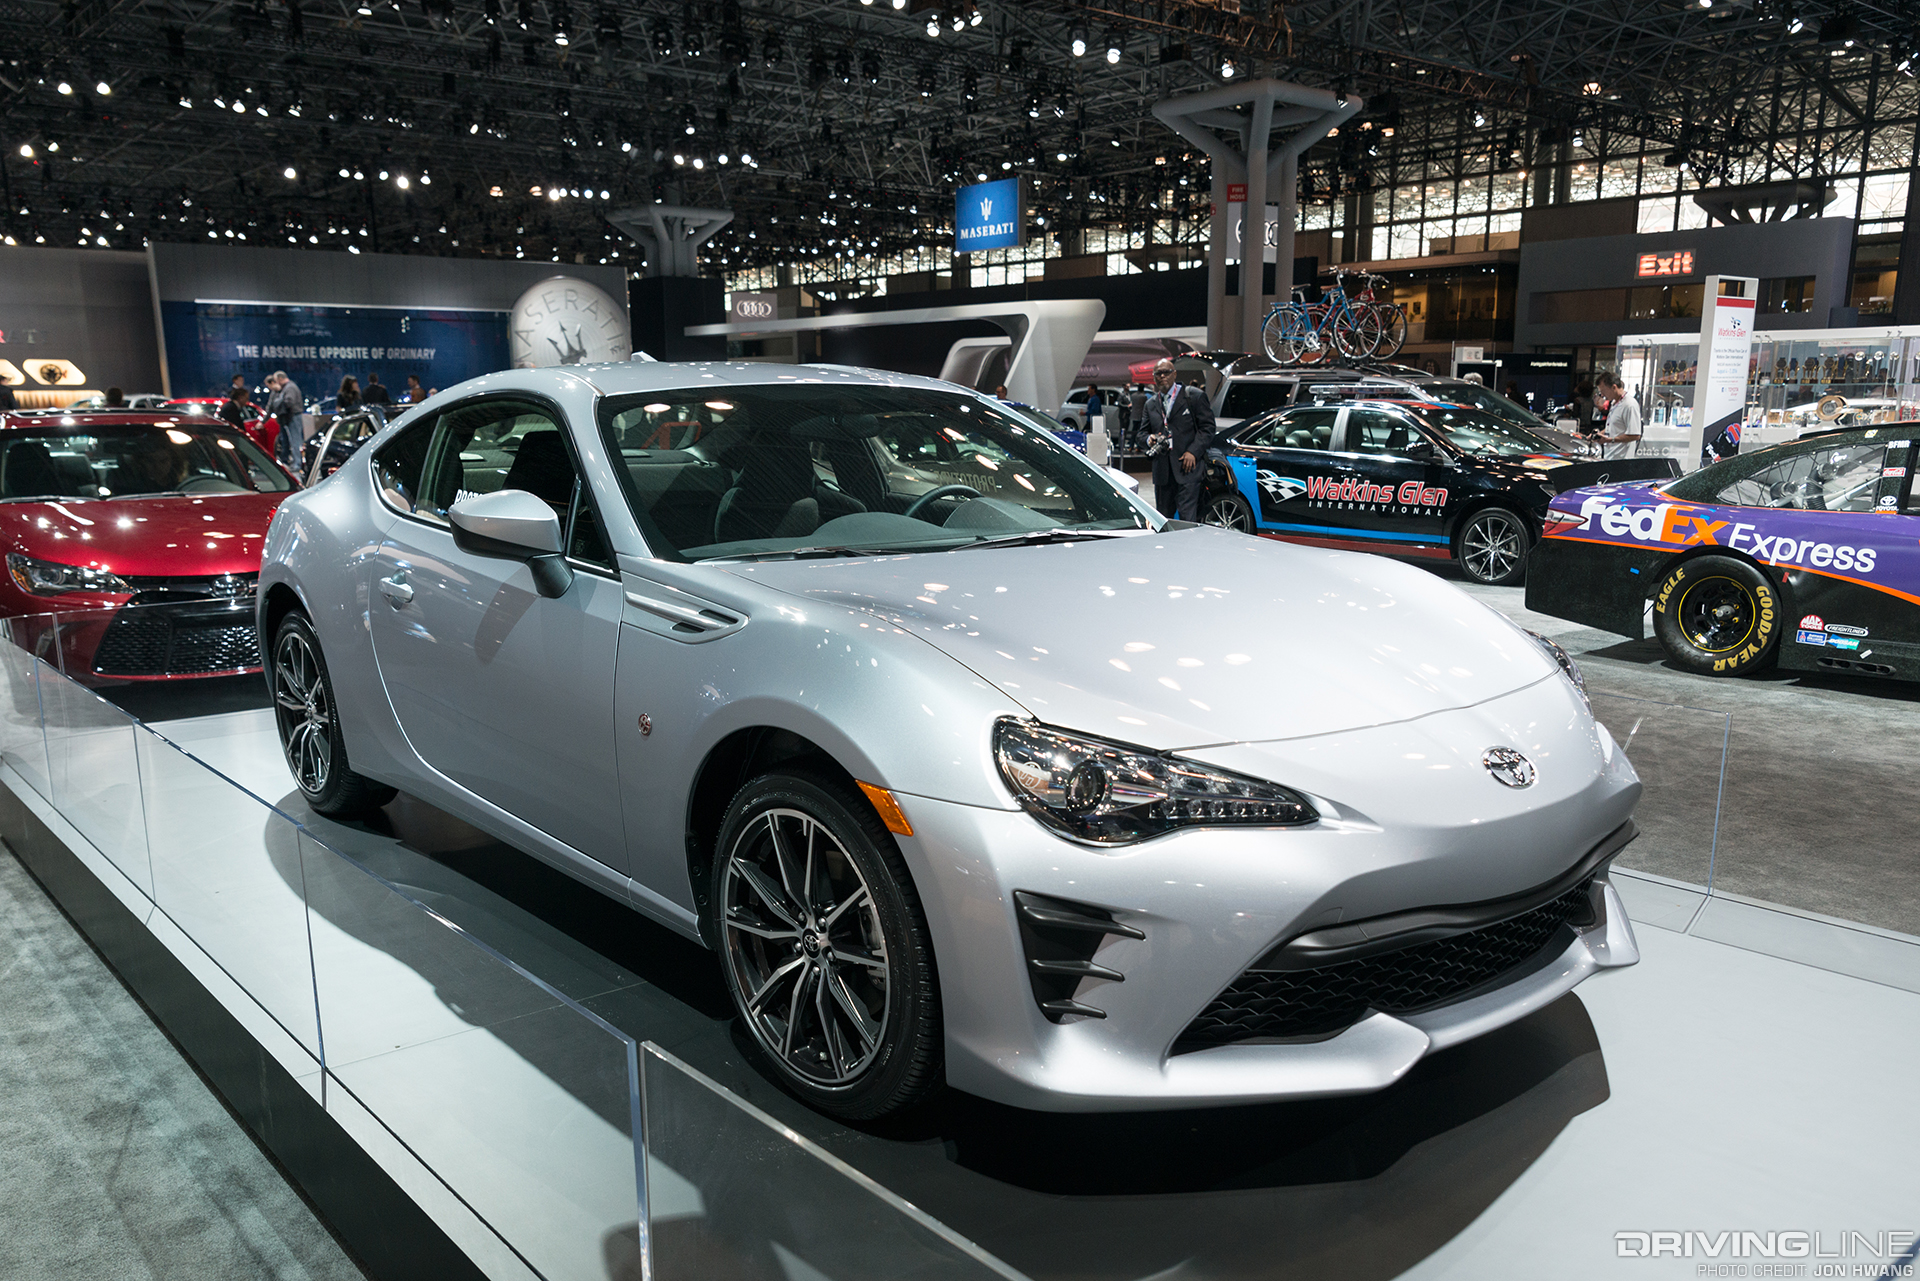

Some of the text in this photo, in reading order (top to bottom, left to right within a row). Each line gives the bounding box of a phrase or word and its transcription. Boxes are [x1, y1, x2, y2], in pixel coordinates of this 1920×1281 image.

[960, 222, 1014, 240] MASERATI
[1638, 251, 1693, 276] Exit
[236, 345, 436, 360] THE ABSOLUTE OPPOSITE OF ORDINARY
[1307, 476, 1448, 507] Watkins Glen
[1308, 501, 1442, 517] INTERNATIONAL
[1577, 496, 1730, 546] FedEx
[1728, 523, 1877, 573] Express
[1656, 567, 1686, 614] EAGLE
[1802, 615, 1822, 626] MAC
